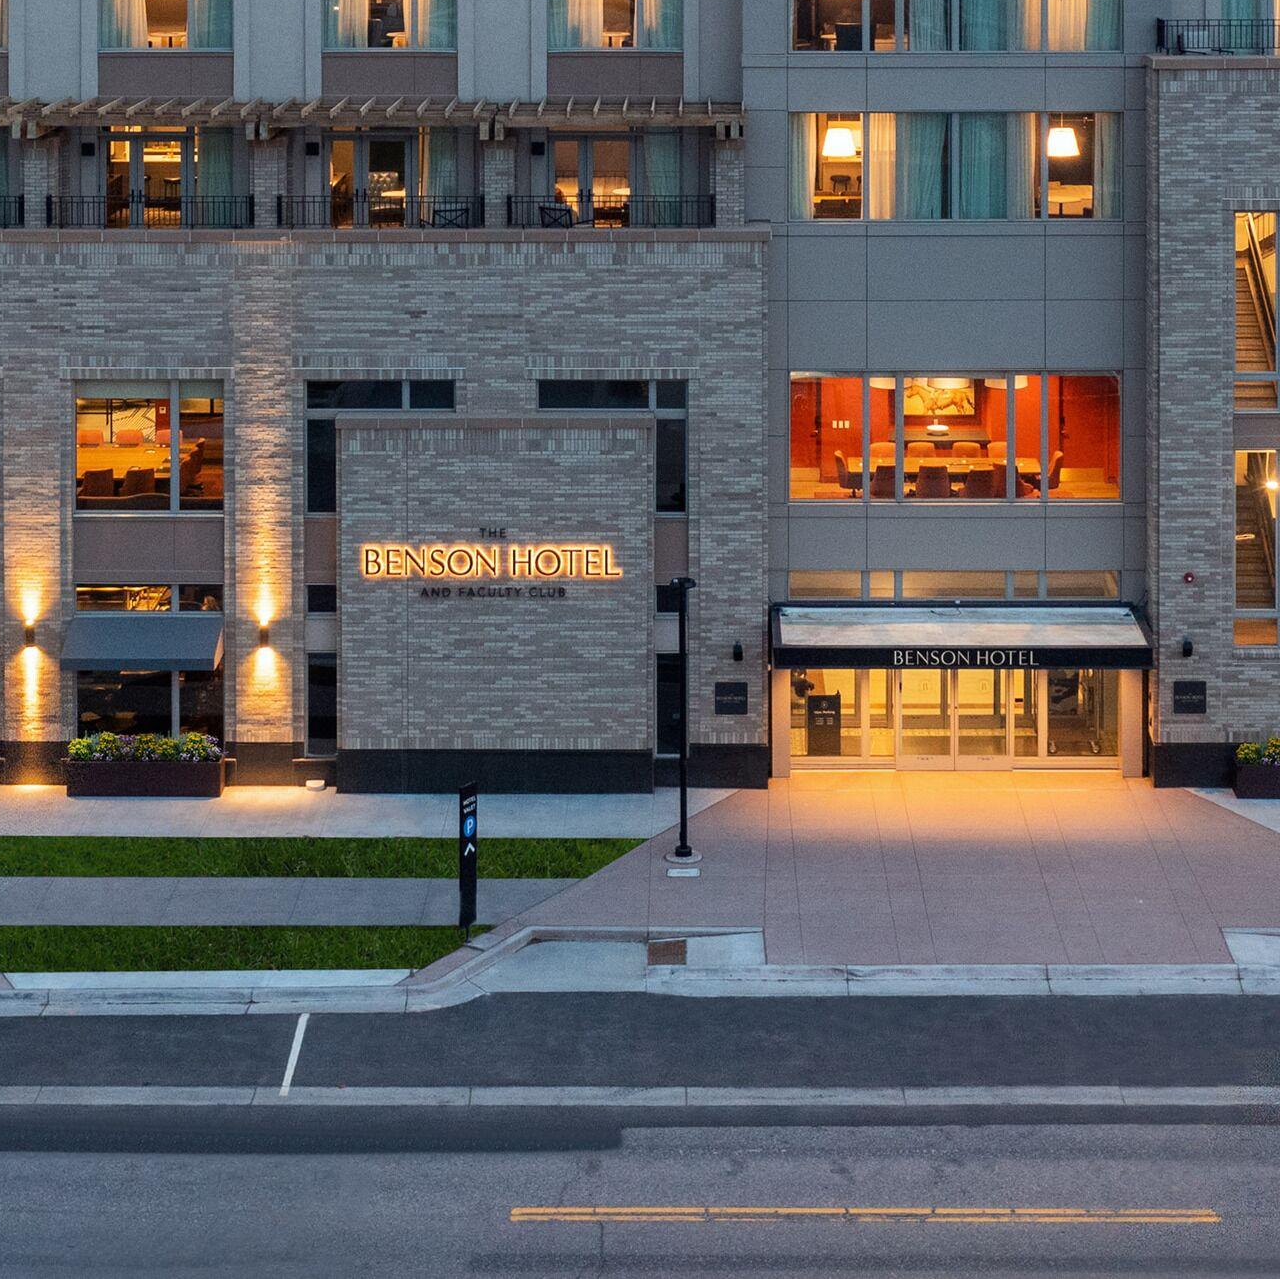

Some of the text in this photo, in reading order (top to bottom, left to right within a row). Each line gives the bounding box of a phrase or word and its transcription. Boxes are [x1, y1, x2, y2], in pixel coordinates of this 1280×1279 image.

[479, 527, 507, 539] THE
[364, 548, 620, 576] BENSON HOTEL
[420, 586, 566, 598] AND FACULTY CLUB
[893, 650, 1040, 666] BENSON HOTEL
[467, 818, 473, 834] P
